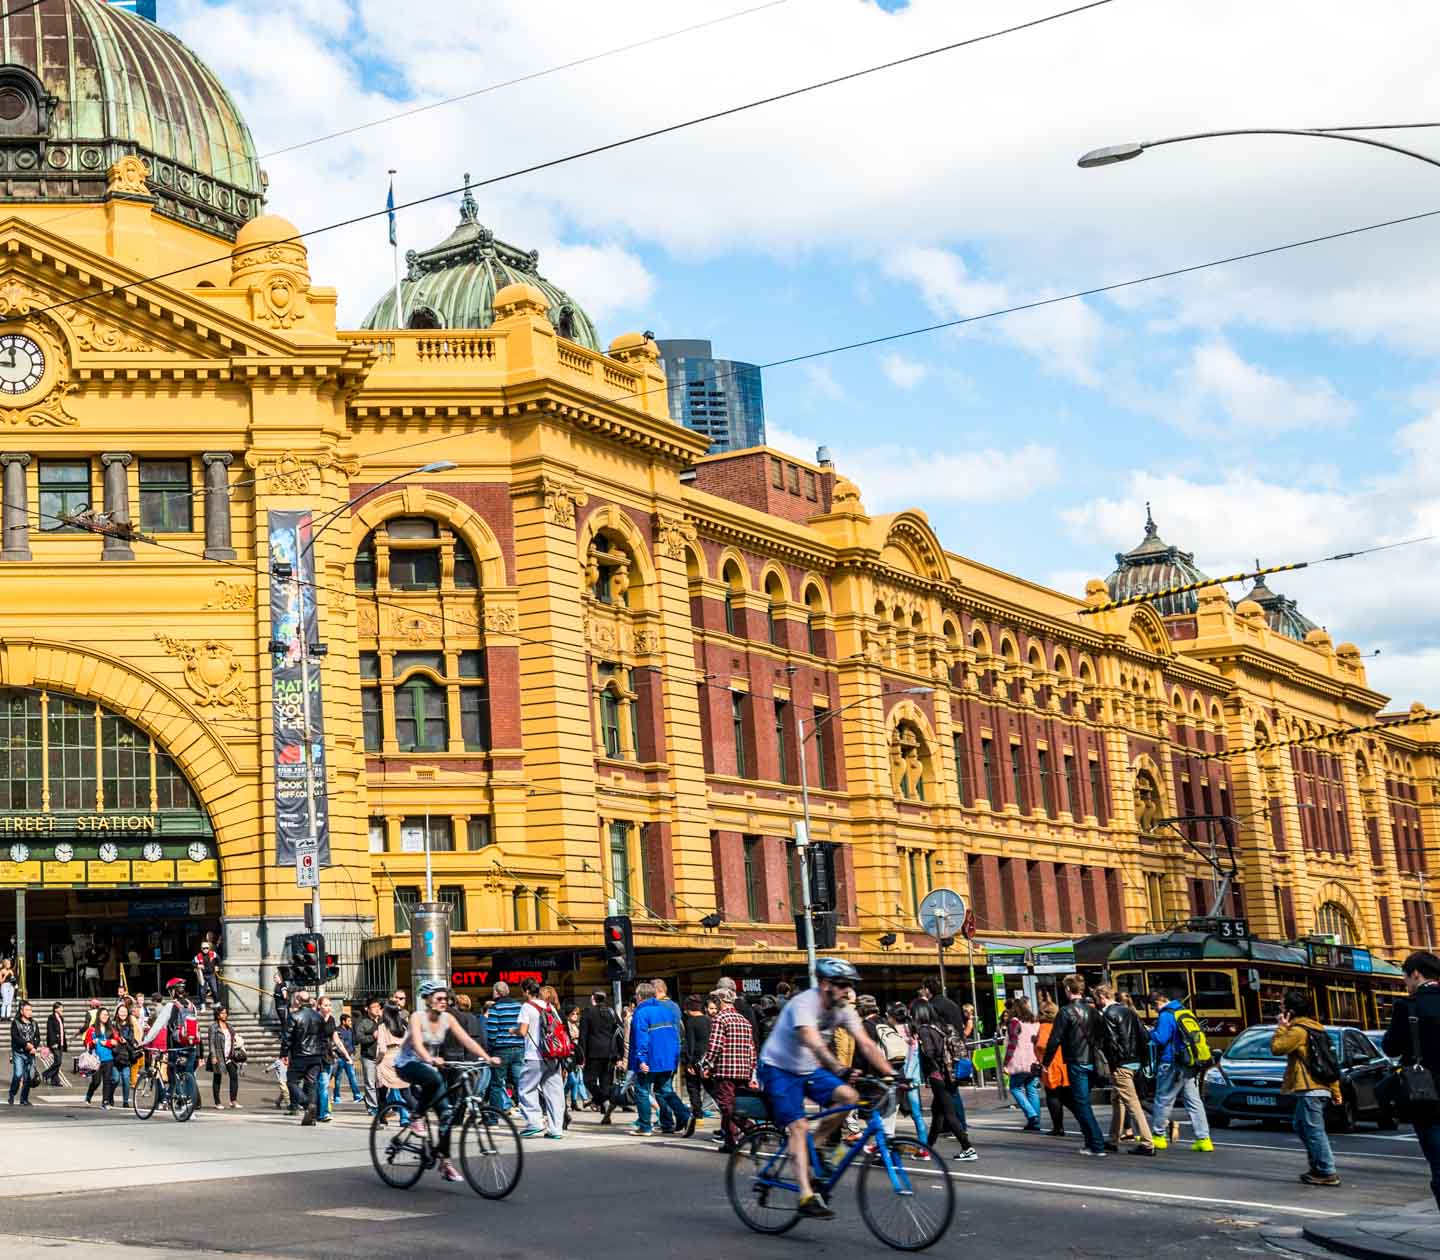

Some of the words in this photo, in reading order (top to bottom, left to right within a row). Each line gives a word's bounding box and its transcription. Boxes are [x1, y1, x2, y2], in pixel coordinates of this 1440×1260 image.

[274, 679, 320, 693] WATH
[279, 717, 305, 730] FEE
[77, 815, 156, 831] STATION
[451, 970, 489, 985] CITY
